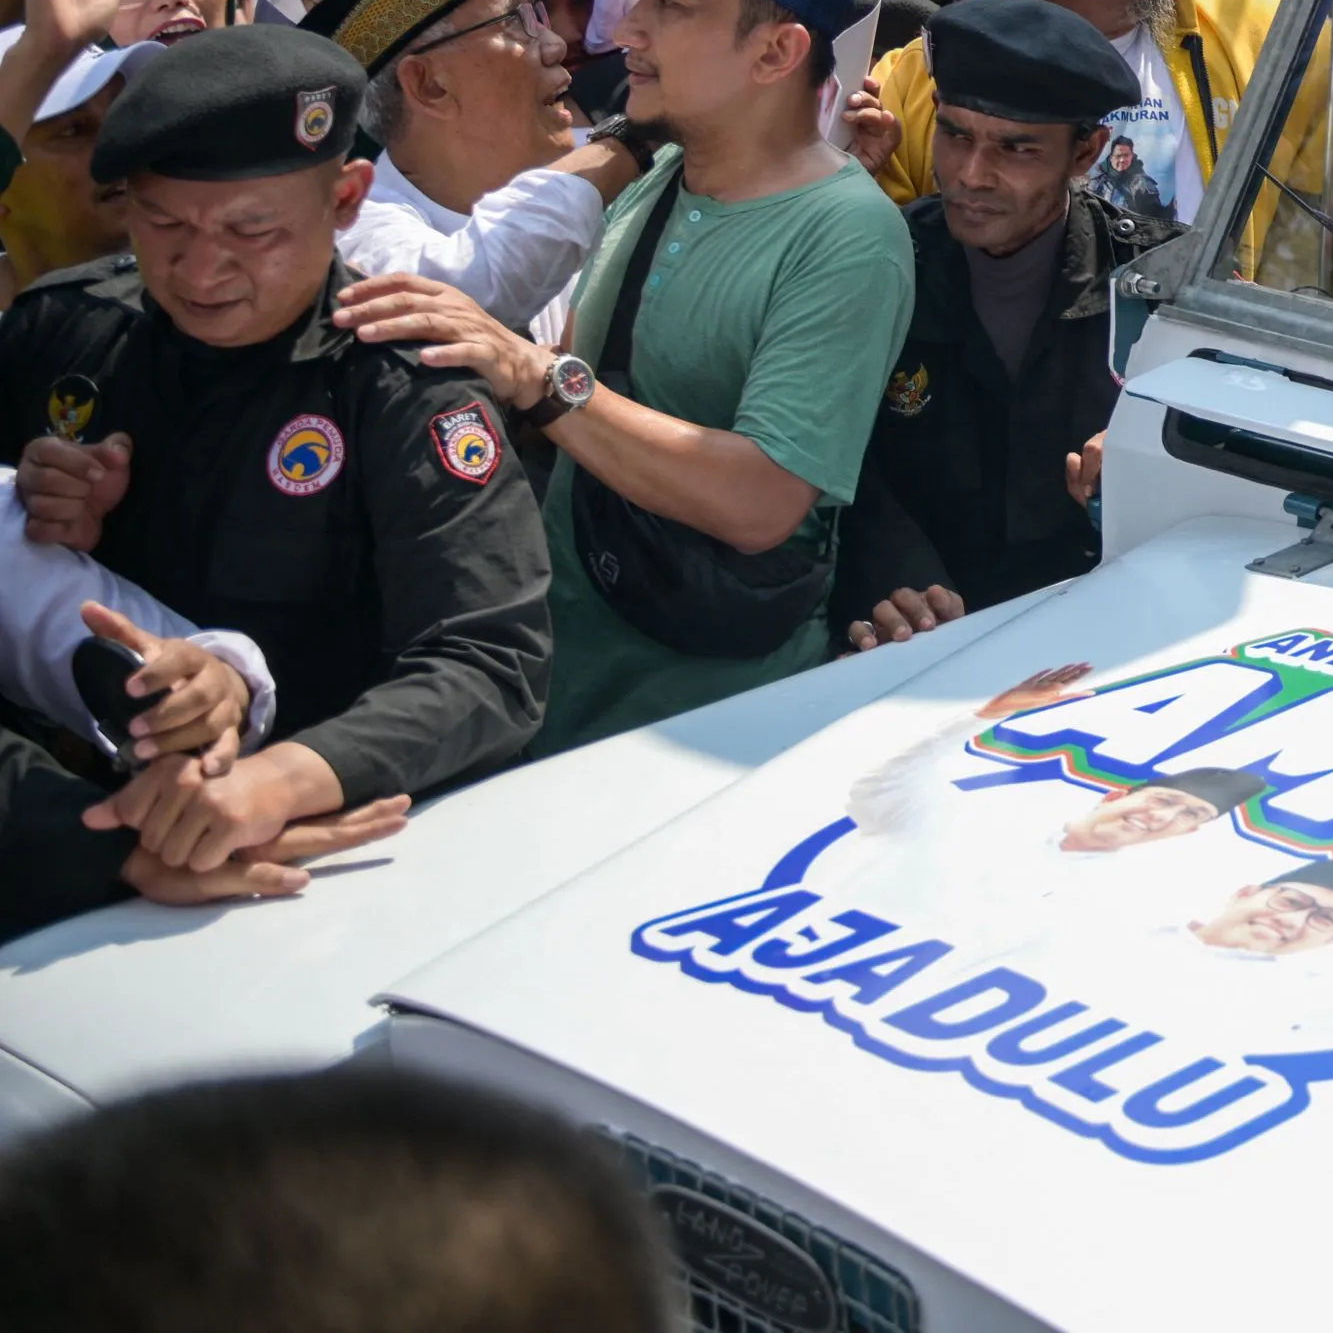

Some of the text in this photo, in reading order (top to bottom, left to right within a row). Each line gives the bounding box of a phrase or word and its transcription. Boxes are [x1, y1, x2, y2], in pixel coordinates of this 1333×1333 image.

[441, 412, 478, 430] BARET
[662, 890, 1270, 1129] AJA DULU
[675, 1200, 746, 1252] LAND
